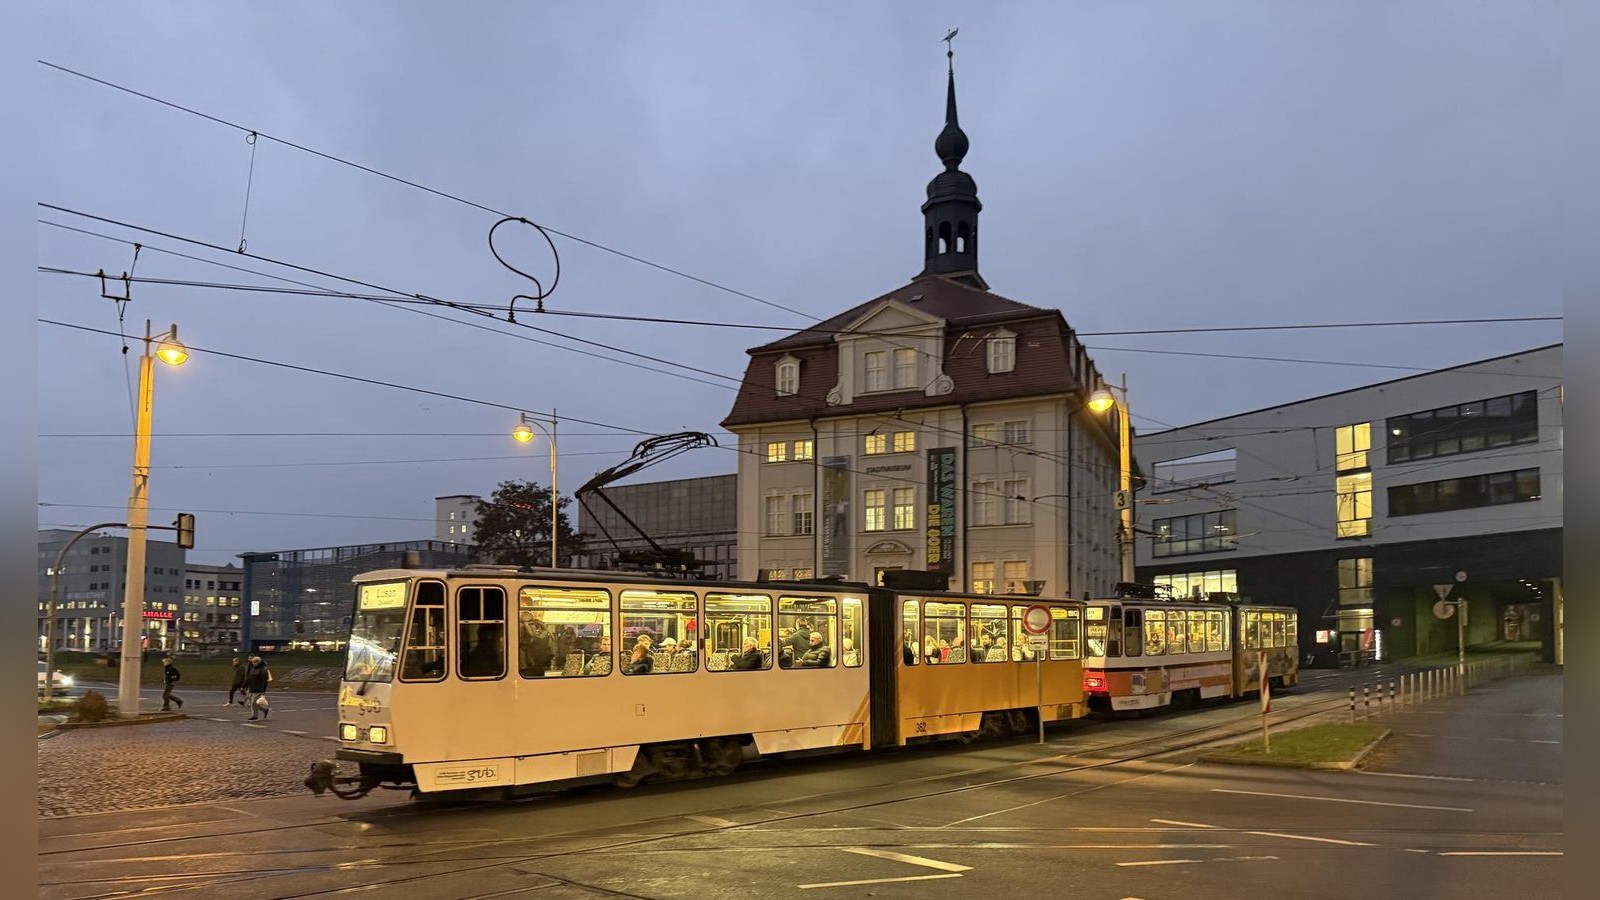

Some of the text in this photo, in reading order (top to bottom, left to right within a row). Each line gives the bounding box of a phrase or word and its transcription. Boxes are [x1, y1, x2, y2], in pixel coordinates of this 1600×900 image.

[941, 453, 955, 482] DAS
[941, 484, 955, 537] WAREN
[1117, 492, 1126, 507] 3
[927, 504, 941, 527] DIE
[362, 590, 369, 606] 3
